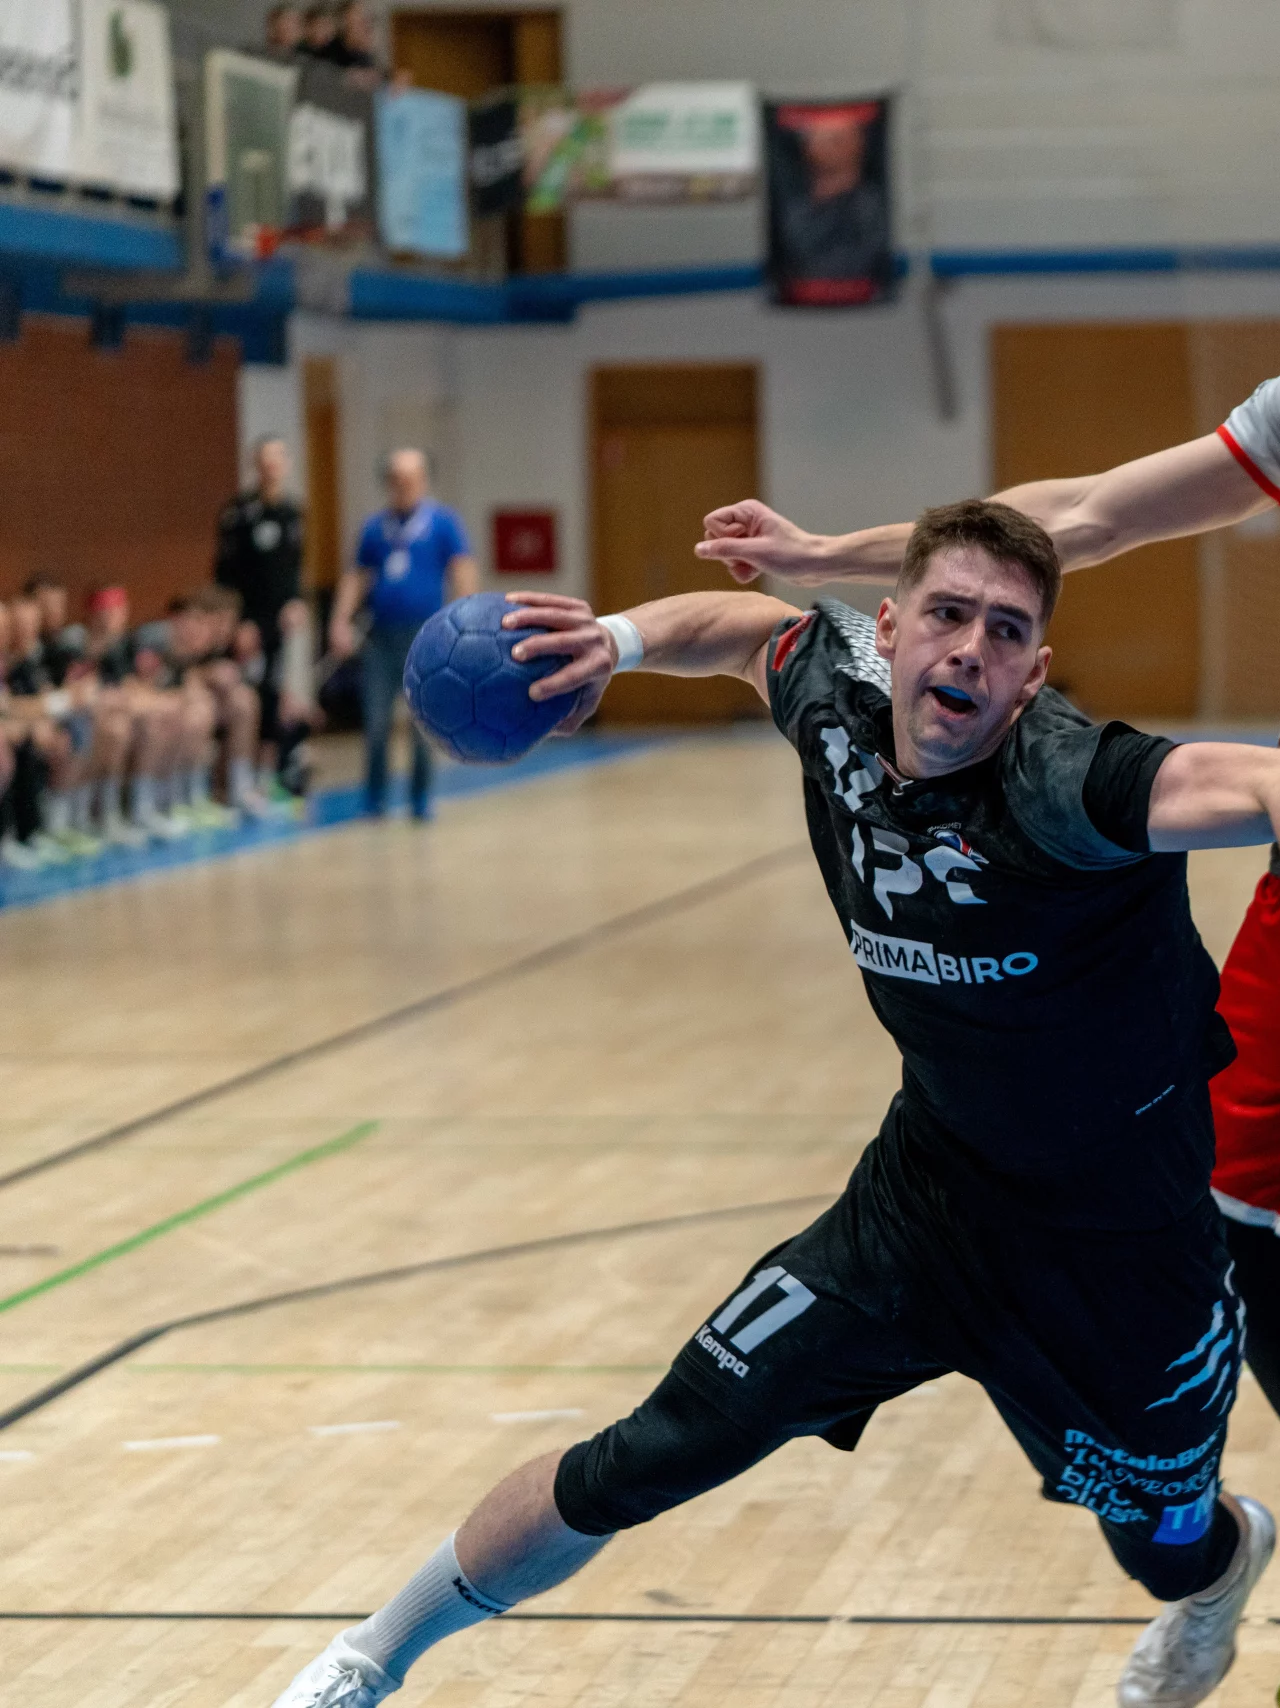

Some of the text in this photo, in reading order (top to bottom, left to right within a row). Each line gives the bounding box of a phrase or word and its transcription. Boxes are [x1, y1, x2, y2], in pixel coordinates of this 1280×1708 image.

[852, 928, 1039, 984] PRIMA BIRO
[711, 1265, 818, 1355] 17
[694, 1324, 750, 1378] Kempa
